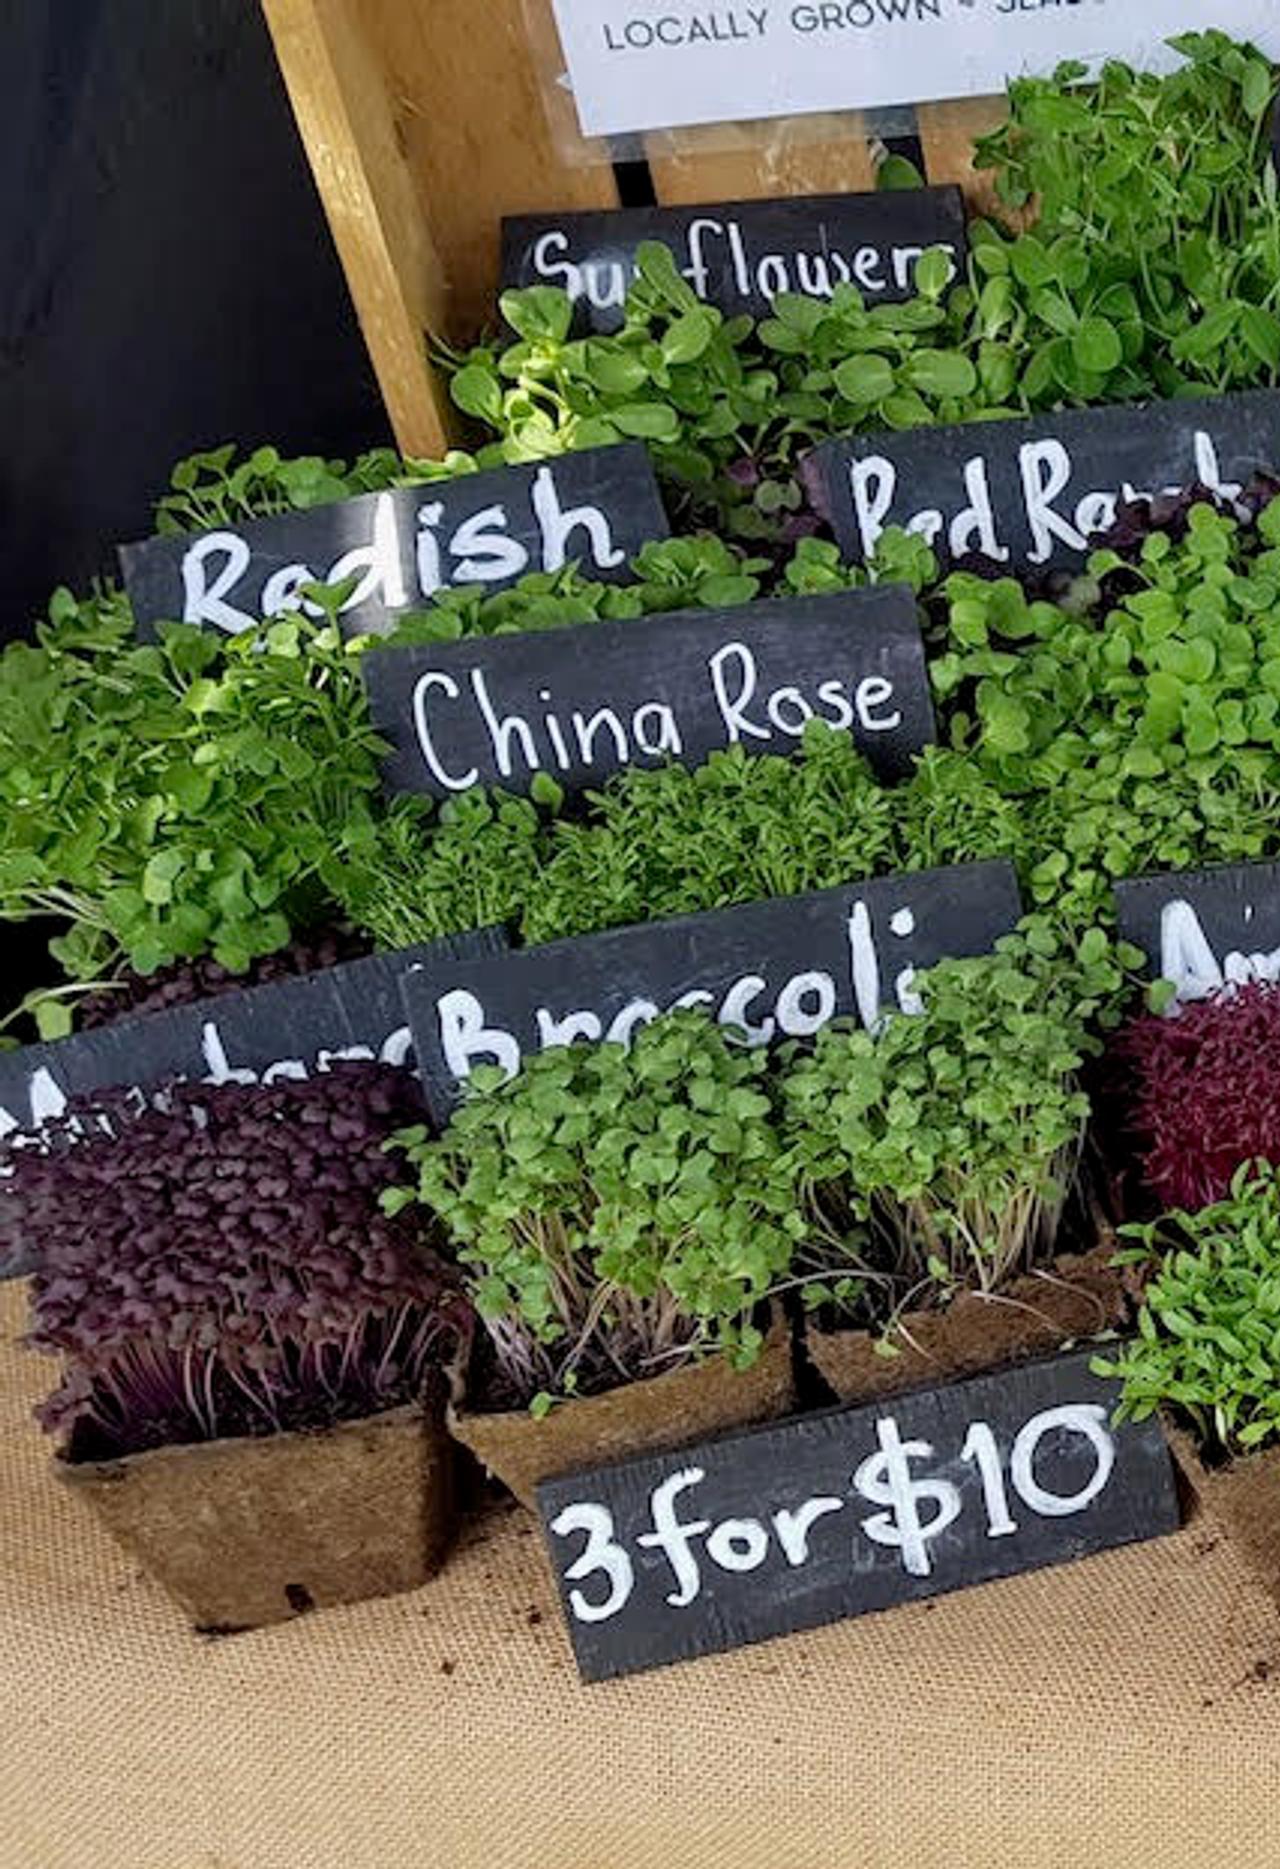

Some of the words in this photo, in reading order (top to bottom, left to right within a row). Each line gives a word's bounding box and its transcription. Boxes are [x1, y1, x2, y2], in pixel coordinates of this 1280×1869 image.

[603, 10, 769, 50] LOCALLY
[792, 0, 942, 33] GROWN
[534, 218, 957, 309] Suflower
[412, 668, 684, 791] China
[707, 641, 903, 749] Rose
[550, 1501, 635, 1623] 3
[637, 1466, 845, 1608] for
[852, 1402, 1116, 1577] $10
